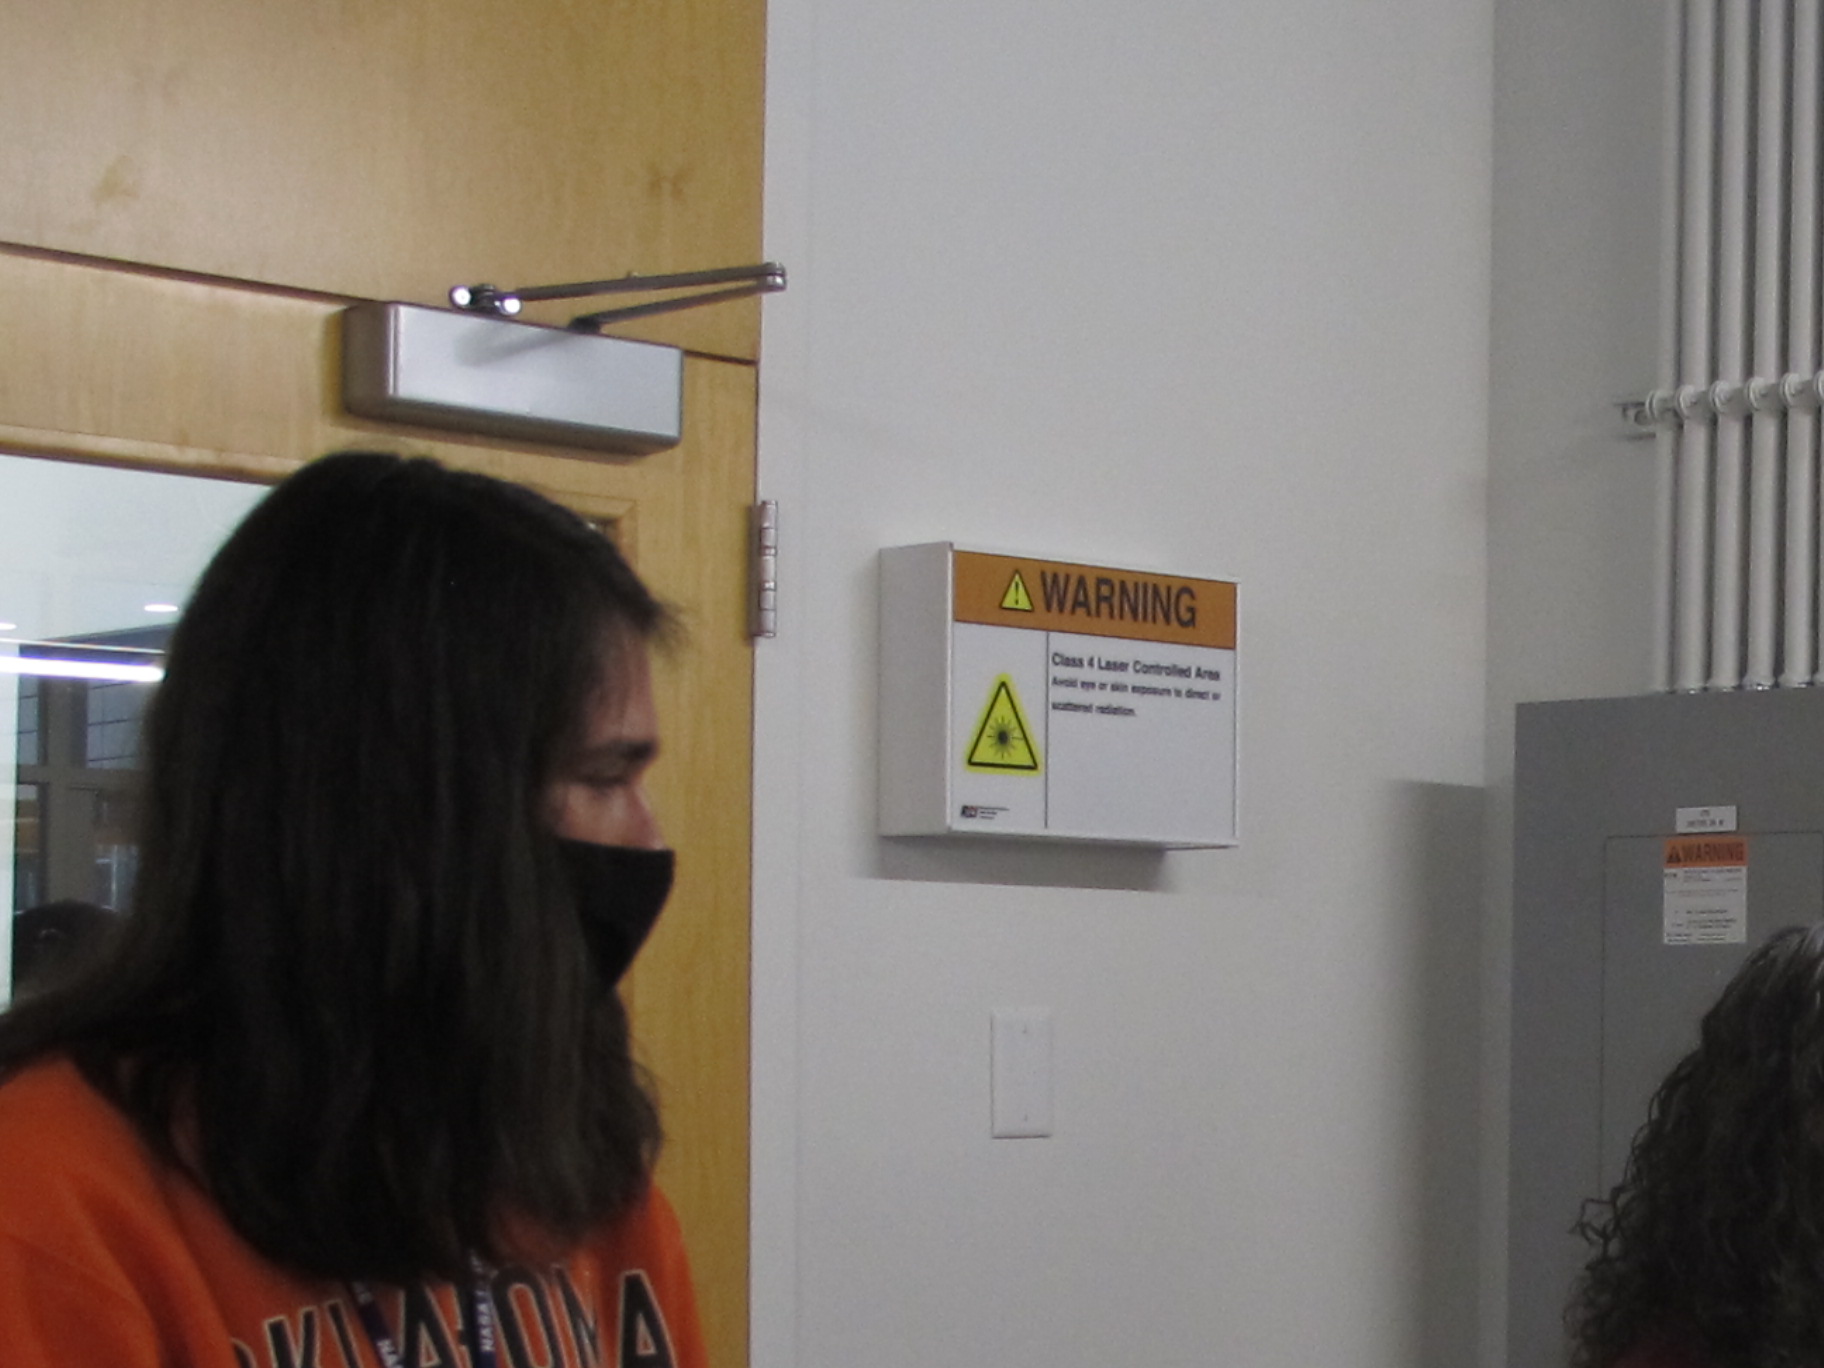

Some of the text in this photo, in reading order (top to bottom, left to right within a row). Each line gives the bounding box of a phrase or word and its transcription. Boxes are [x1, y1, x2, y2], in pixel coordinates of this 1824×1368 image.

[1041, 570, 1197, 628] WARNING
[1052, 652, 1221, 681] Class 4 Laser Controlled Area
[1052, 676, 1078, 688] Avoid
[1080, 681, 1096, 691] eye
[1110, 682, 1129, 692] skin
[1131, 685, 1172, 697] exposure
[1174, 688, 1182, 698] to
[1185, 688, 1210, 700] direct
[1052, 701, 1093, 713] scattered
[1683, 842, 1744, 862] WARNING
[476, 1301, 496, 1352] NASA
